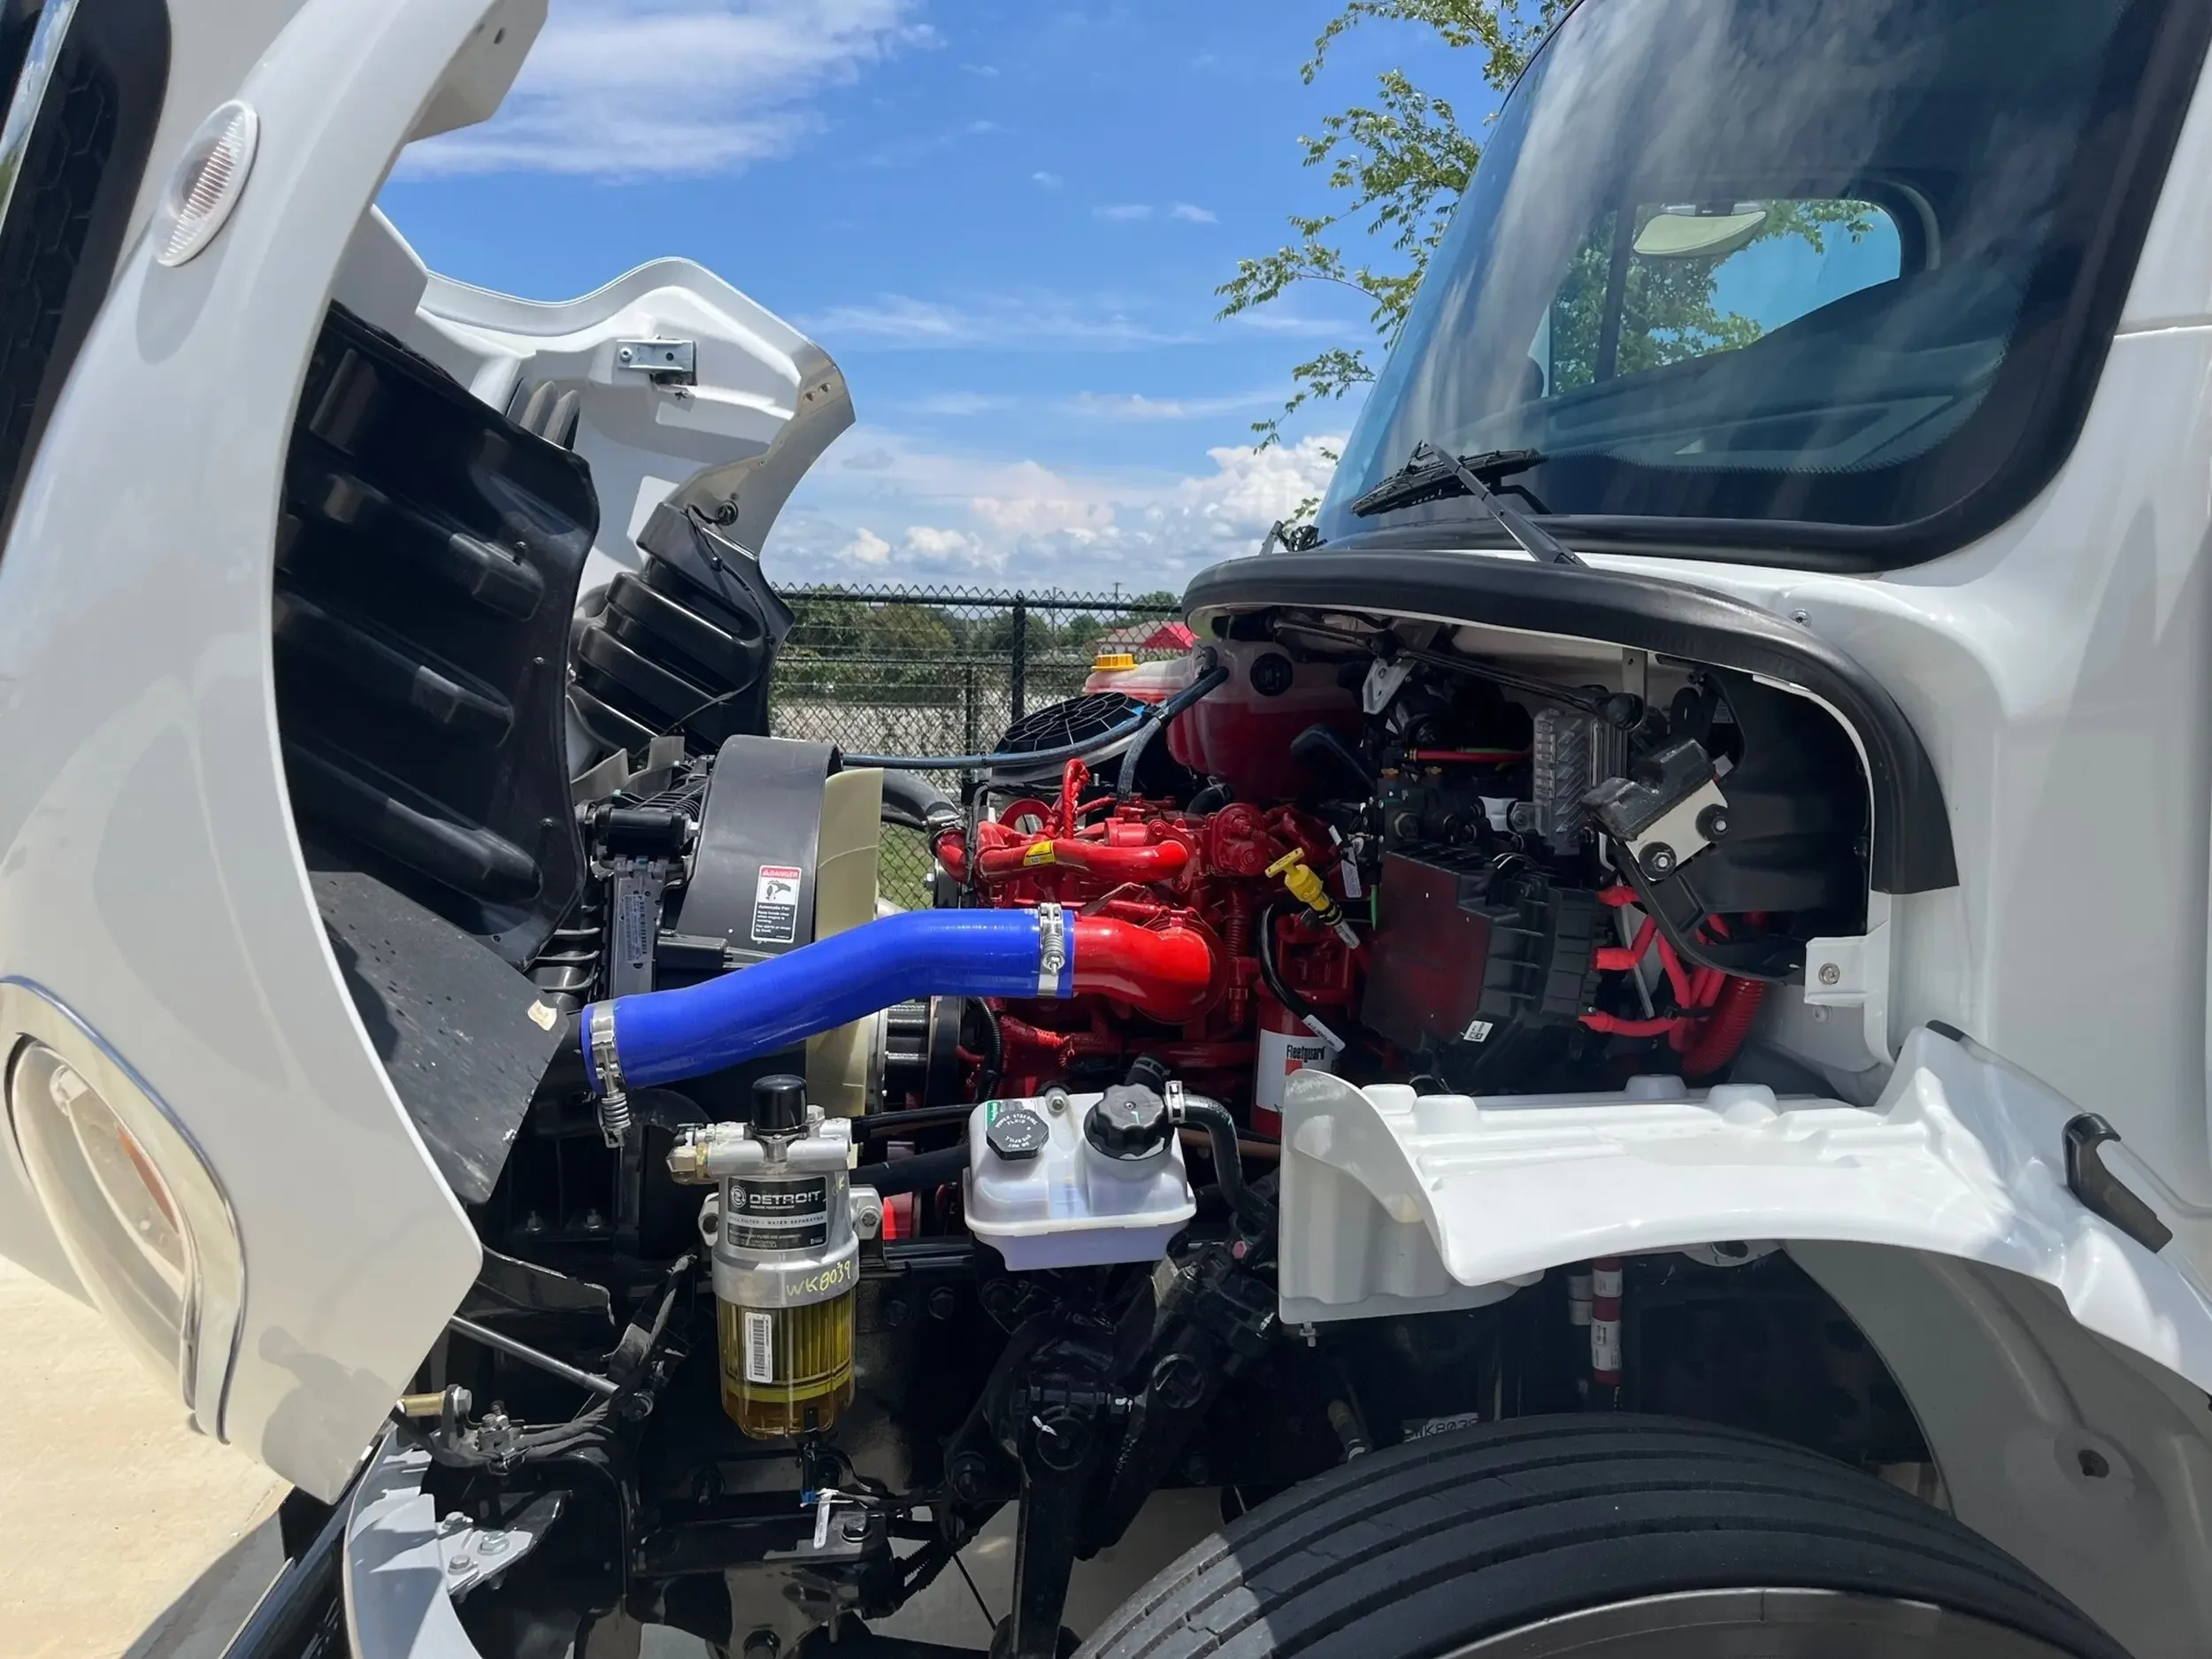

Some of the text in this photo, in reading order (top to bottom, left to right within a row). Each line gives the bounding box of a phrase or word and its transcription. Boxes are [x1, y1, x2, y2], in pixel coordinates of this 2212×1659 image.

[1286, 1045, 1325, 1063] Fleetguard
[1012, 1113, 1039, 1125] STEERING
[749, 1190, 823, 1204] DETROIT
[790, 1216, 824, 1225] SEPARATOR
[786, 1260, 850, 1296] WK8039
